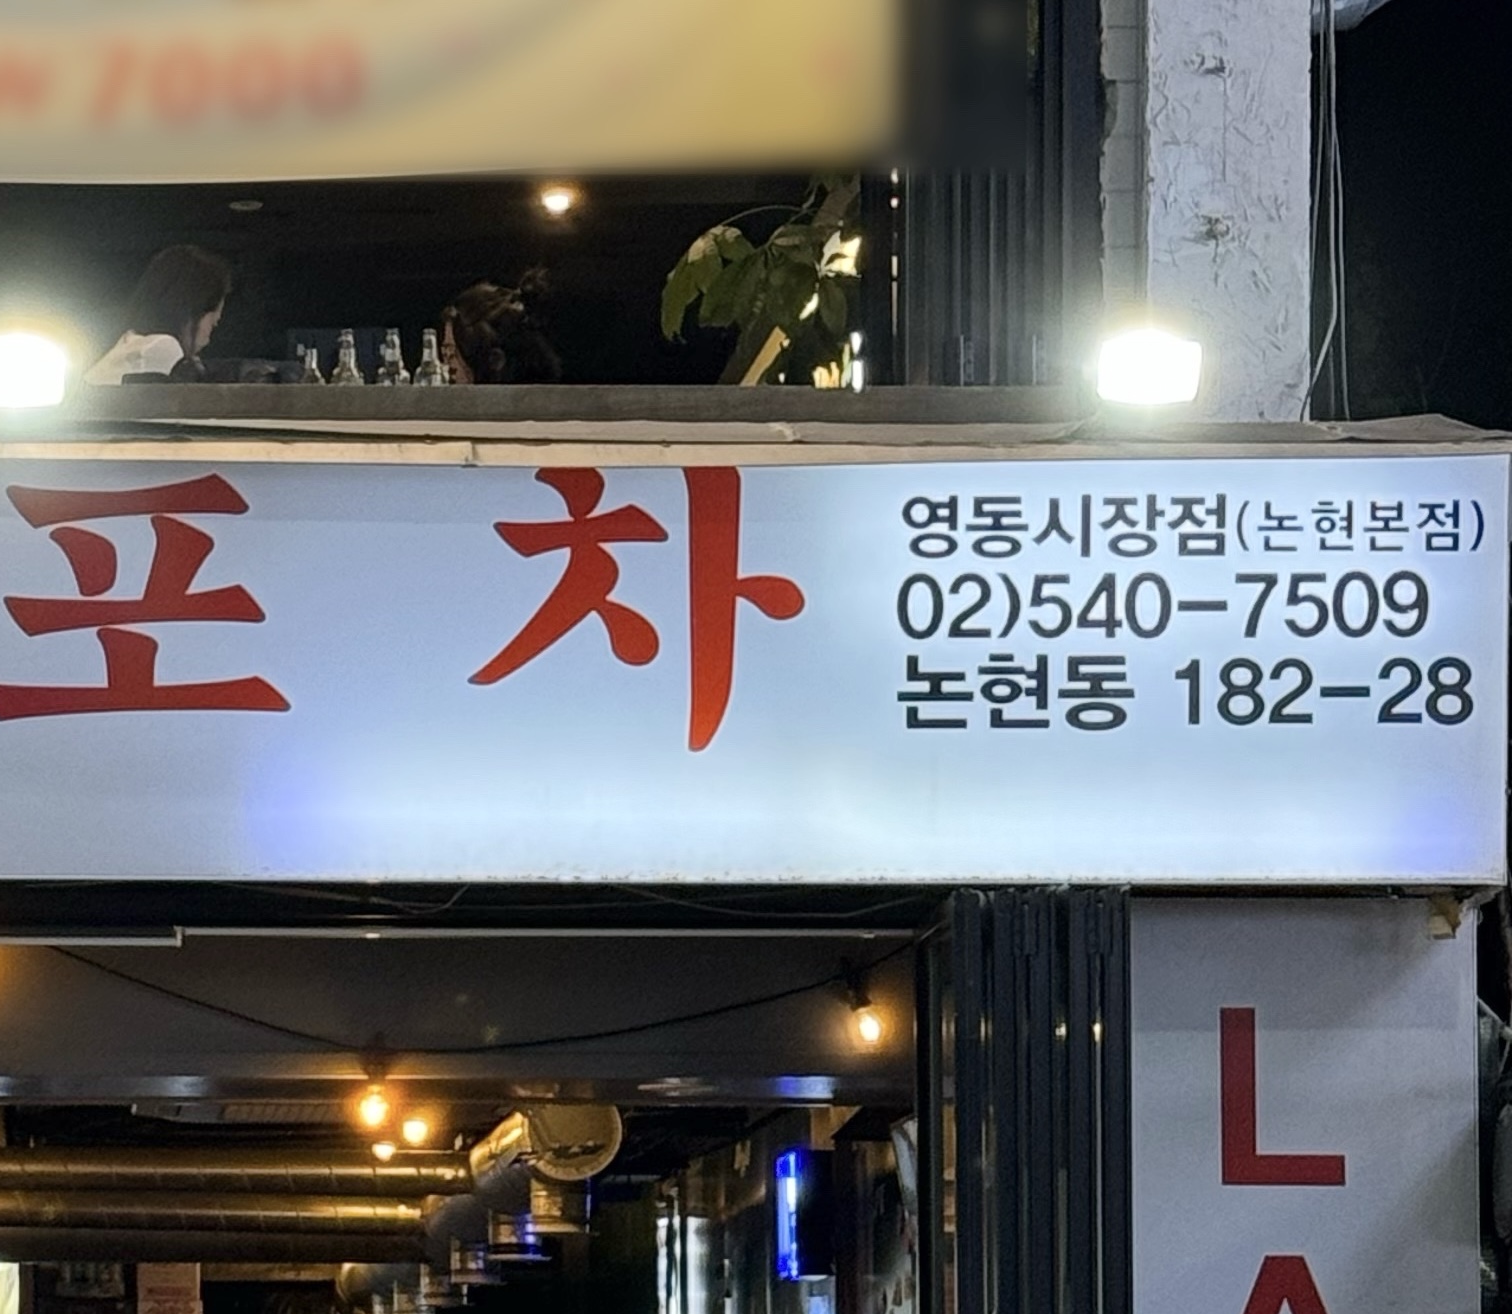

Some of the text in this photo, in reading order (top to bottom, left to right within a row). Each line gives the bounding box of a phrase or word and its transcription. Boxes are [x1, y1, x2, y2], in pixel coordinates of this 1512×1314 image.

[895, 569, 1431, 640] 02)540-7509
[895, 652, 1476, 732] 논현동 182-28
